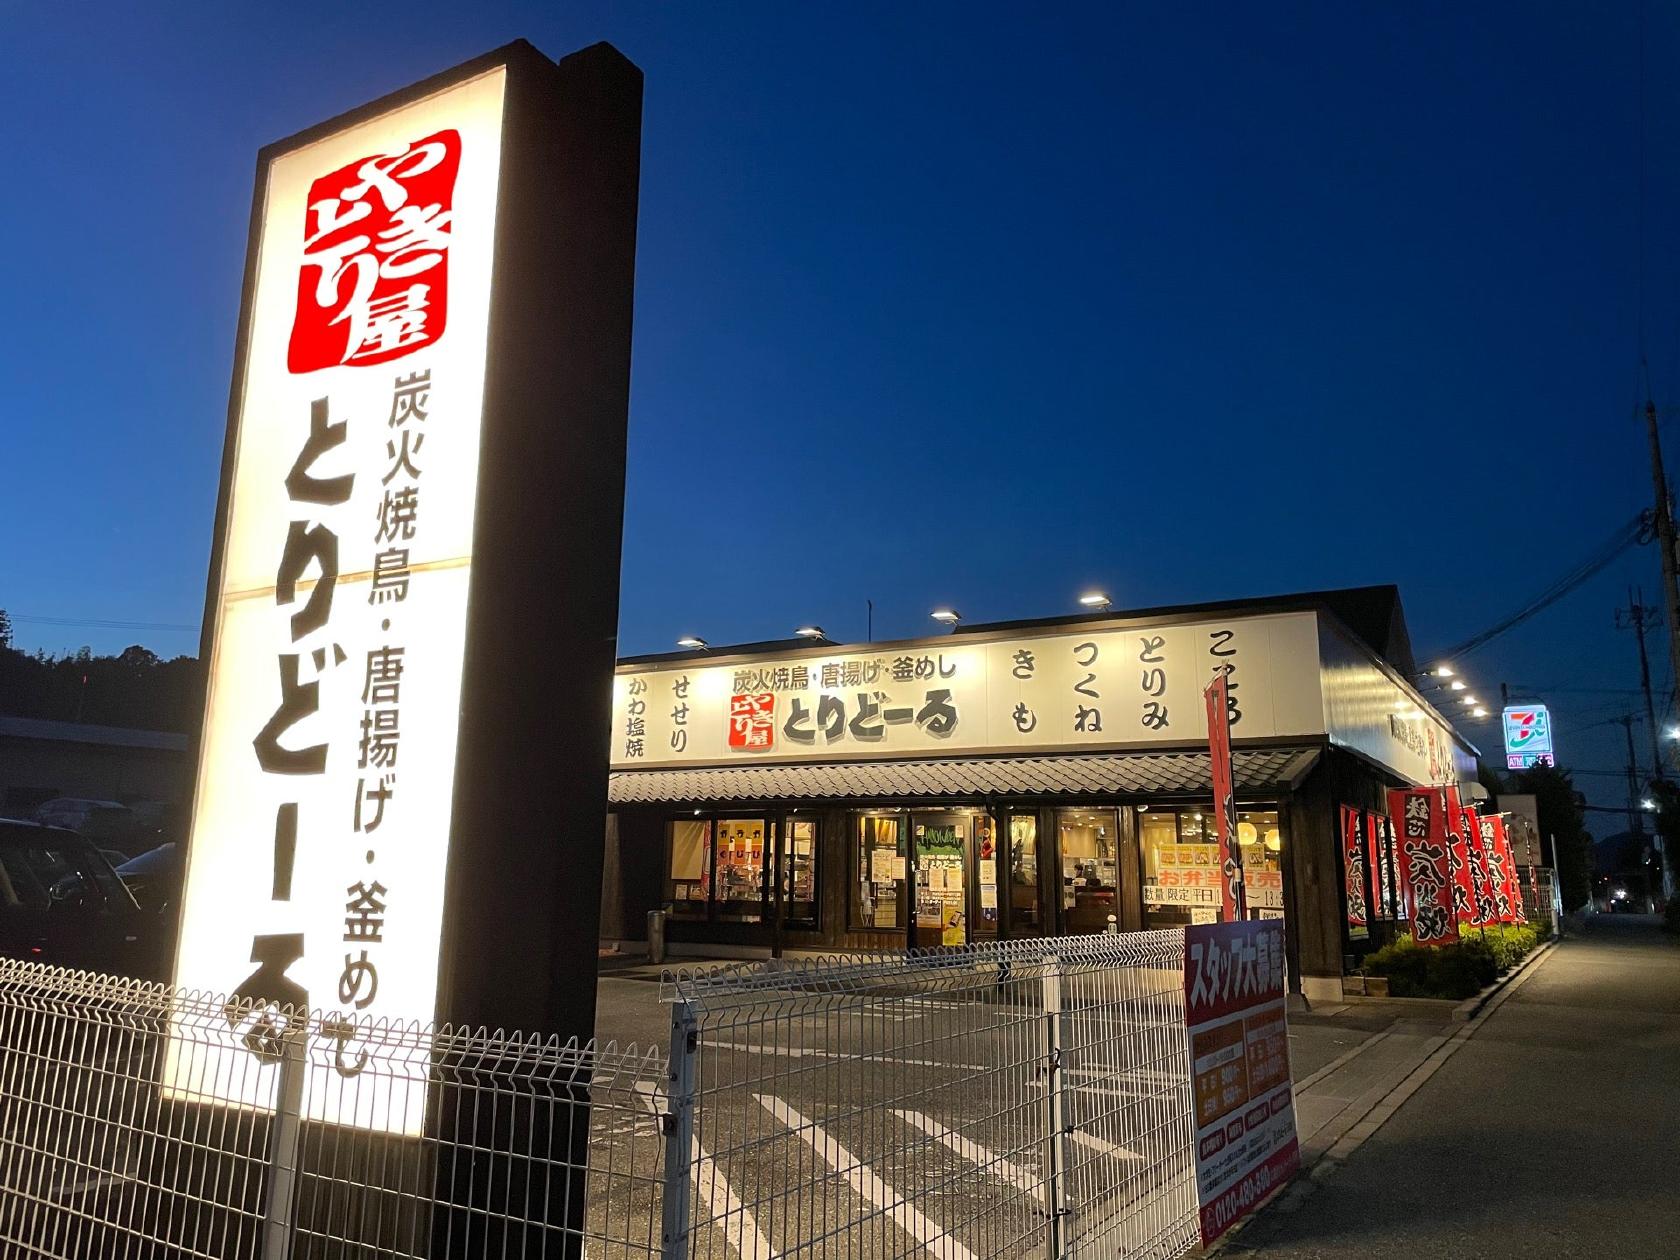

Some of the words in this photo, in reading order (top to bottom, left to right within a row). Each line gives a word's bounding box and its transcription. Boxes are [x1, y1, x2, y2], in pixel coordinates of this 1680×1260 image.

[670, 674, 692, 753] せせり
[732, 653, 957, 693] 炭火焼鳥・唐揚げ・釜めし
[1011, 649, 1037, 734] きも
[1073, 641, 1103, 733] つくね
[1139, 635, 1169, 731] とりみ
[228, 395, 356, 1066] とりどーる
[624, 677, 648, 759] かわ塩焼
[783, 688, 959, 743] とりどーる
